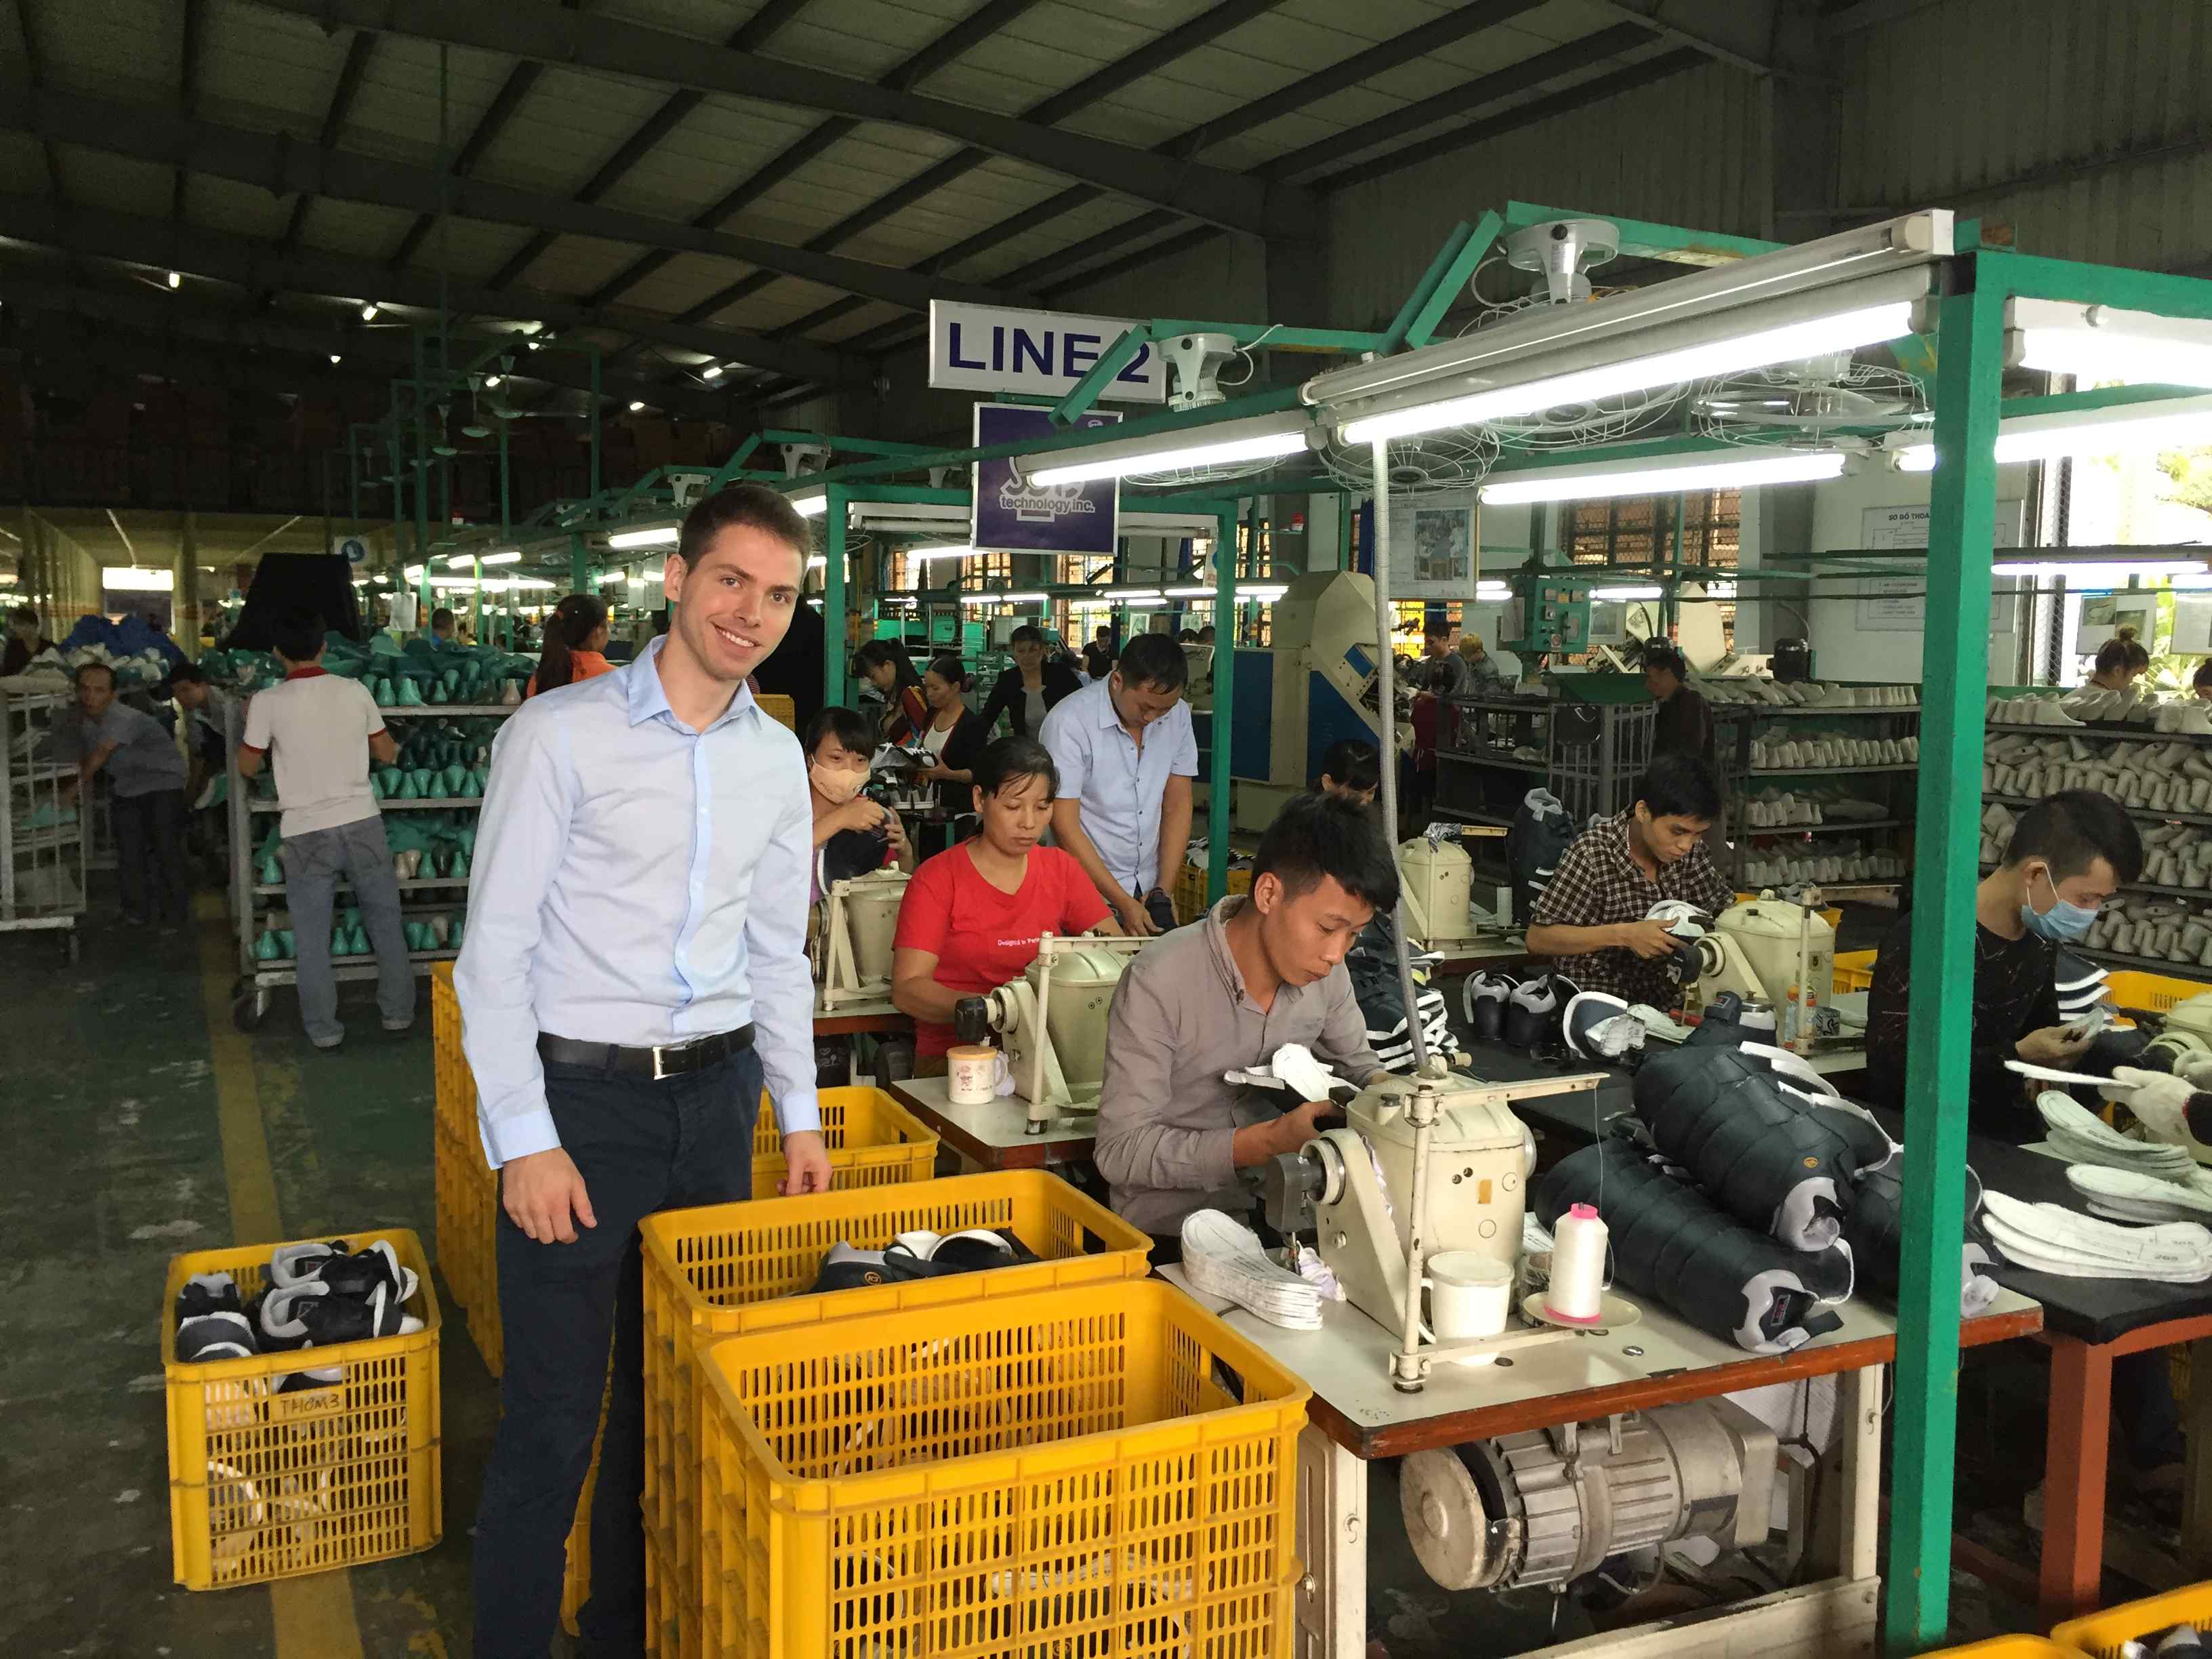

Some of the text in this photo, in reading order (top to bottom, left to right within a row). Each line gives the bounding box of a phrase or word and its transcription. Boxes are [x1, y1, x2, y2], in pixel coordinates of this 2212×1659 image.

[949, 322, 1150, 384] LINE 2
[1002, 495, 1069, 512] technology
